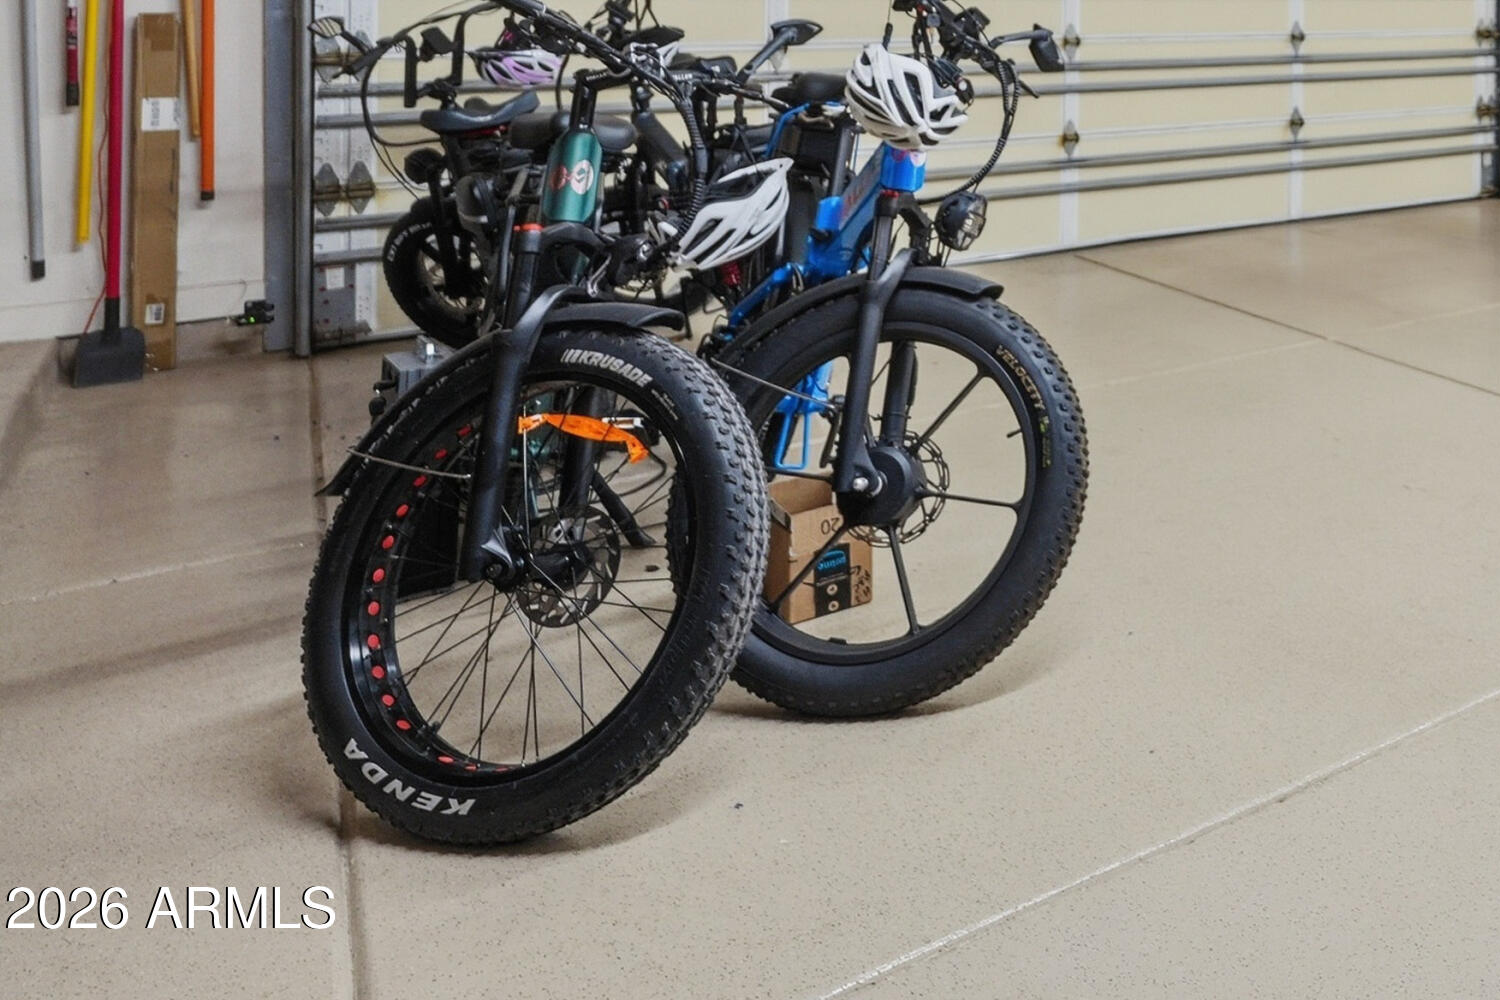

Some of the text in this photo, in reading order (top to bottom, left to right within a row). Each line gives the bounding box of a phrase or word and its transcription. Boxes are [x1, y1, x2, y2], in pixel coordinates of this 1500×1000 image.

[579, 349, 654, 388] KRUSADE
[996, 344, 1046, 411] VELOCITY
[343, 737, 477, 816] KENDA
